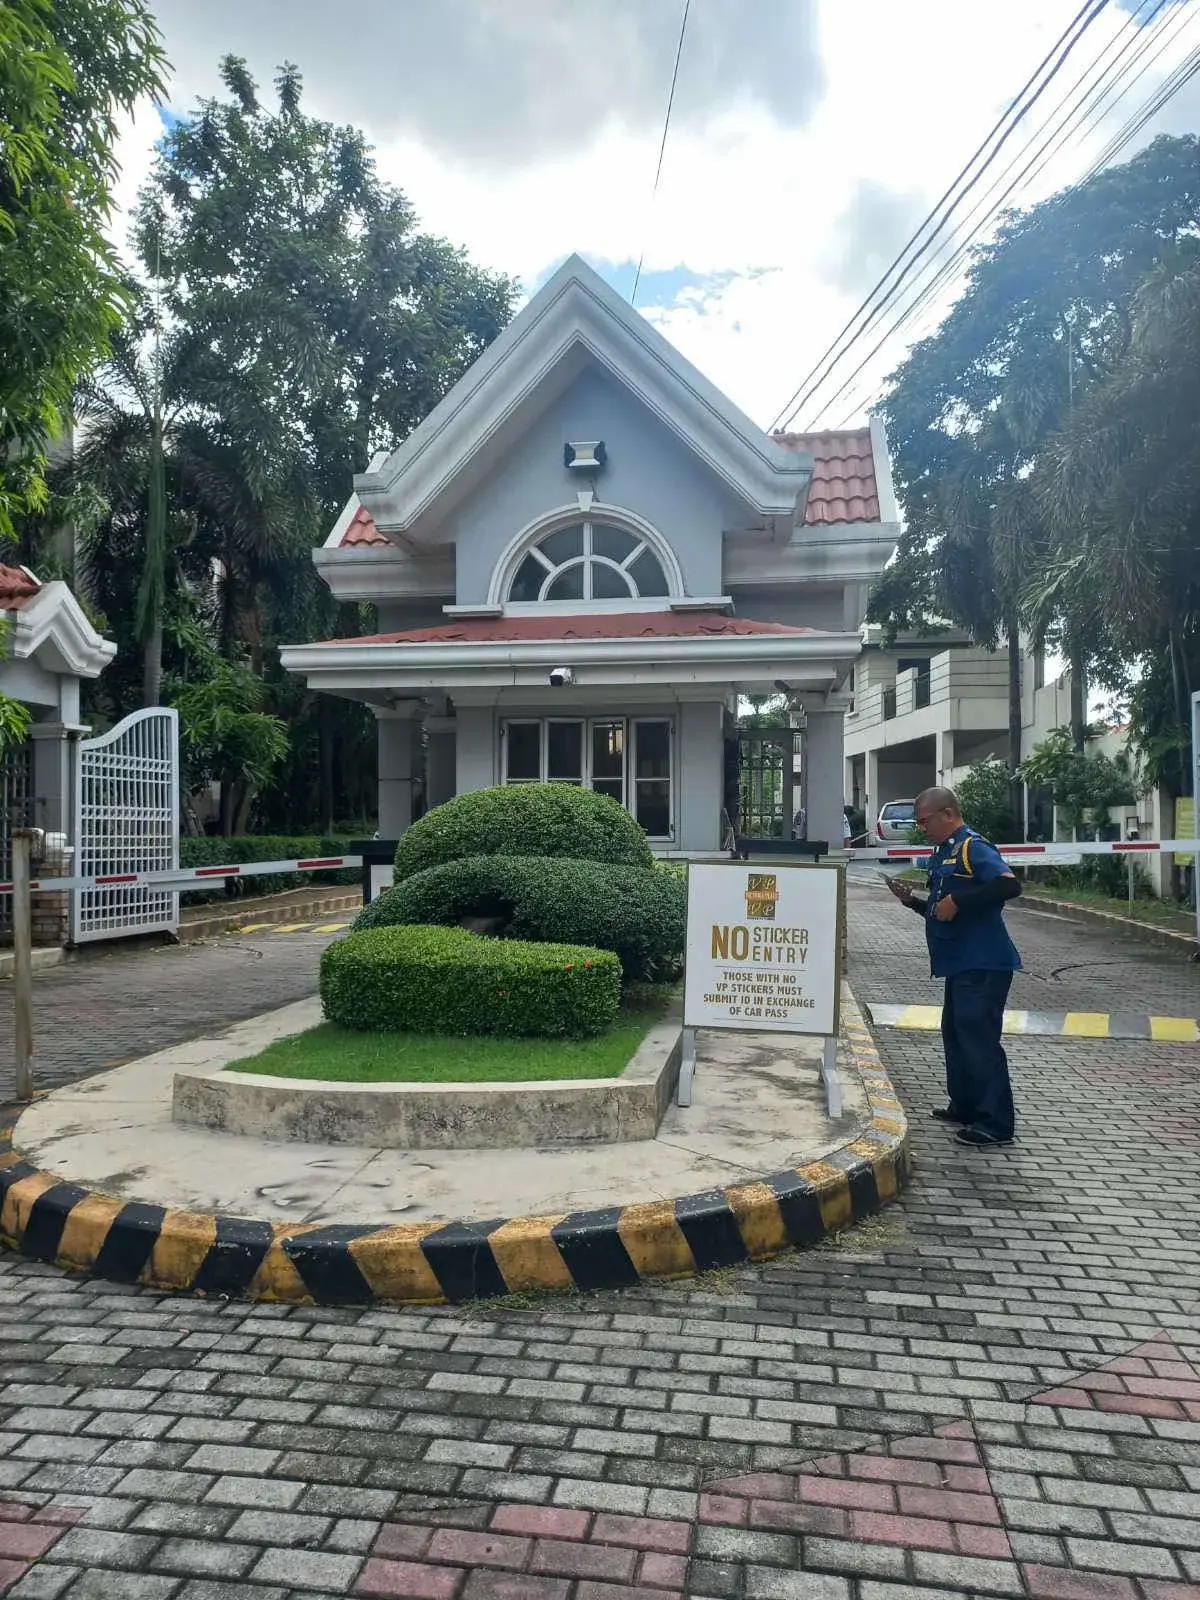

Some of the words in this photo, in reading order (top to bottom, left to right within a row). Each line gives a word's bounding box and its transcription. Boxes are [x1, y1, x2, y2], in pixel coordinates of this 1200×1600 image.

[712, 925, 749, 961] NO
[753, 927, 809, 945] STICKER
[752, 946, 808, 964] ENTRY
[723, 972, 753, 982] THOSE
[756, 973, 780, 983] WITH
[783, 974, 797, 984] NO
[716, 983, 728, 992] VP
[731, 983, 774, 994] STICKERS
[777, 987, 802, 996] MUST
[703, 994, 737, 1004] SUBMIT
[741, 995, 752, 1005] ID
[754, 996, 763, 1005] IN
[766, 997, 816, 1009] EXCHANGE
[729, 1006, 742, 1016] OF
[744, 1007, 762, 1017] CAR
[765, 1008, 789, 1018] PASS
